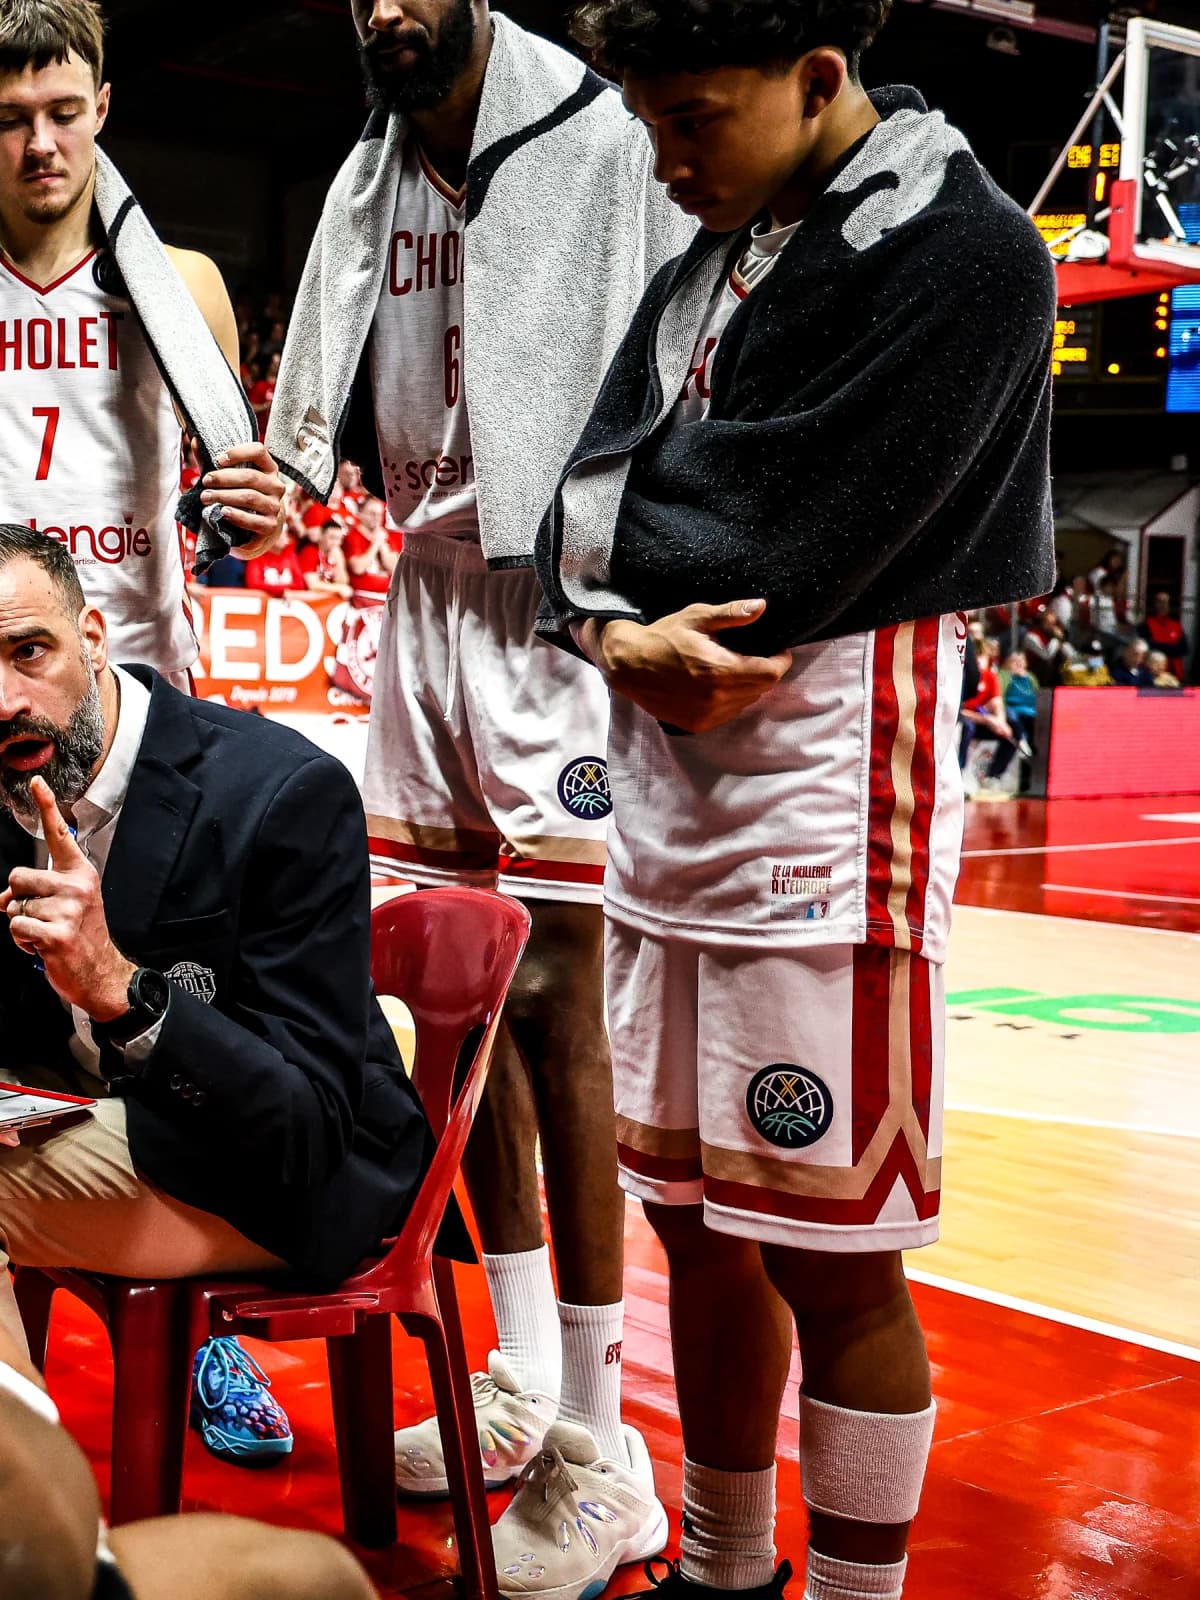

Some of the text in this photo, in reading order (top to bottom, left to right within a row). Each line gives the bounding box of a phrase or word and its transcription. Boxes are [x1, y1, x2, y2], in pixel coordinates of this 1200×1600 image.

[389, 230, 464, 297] CHO
[444, 324, 461, 409] 6
[32, 406, 60, 481] 7
